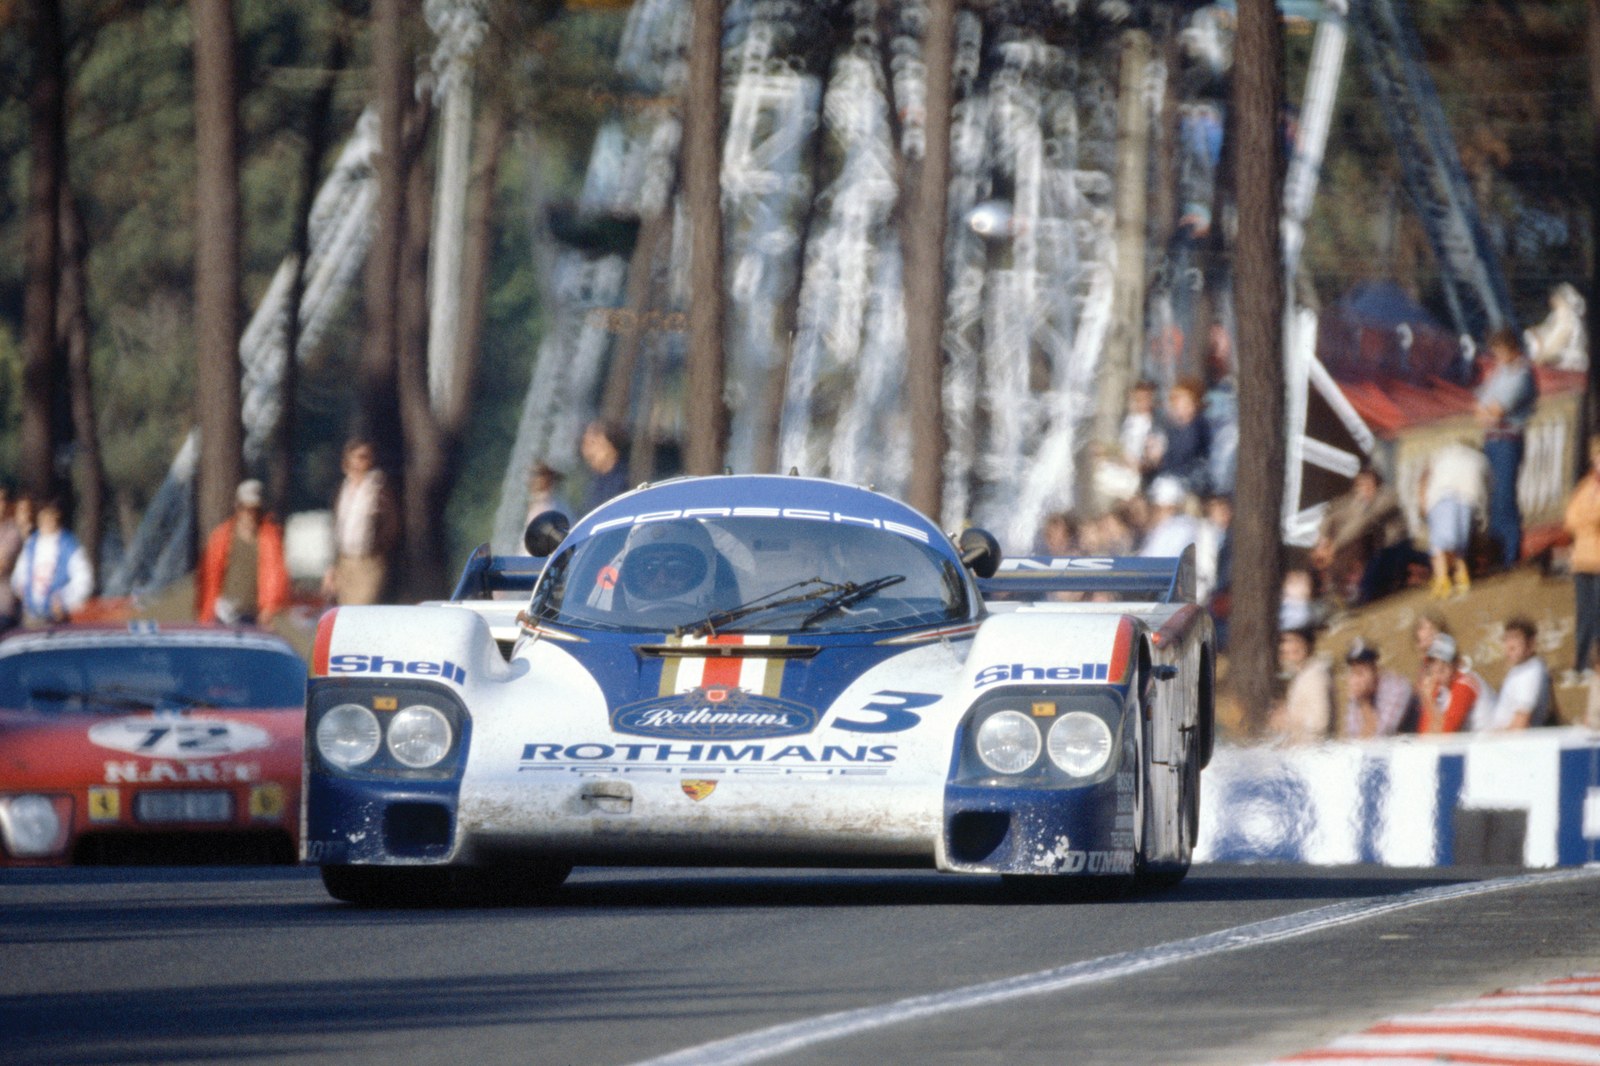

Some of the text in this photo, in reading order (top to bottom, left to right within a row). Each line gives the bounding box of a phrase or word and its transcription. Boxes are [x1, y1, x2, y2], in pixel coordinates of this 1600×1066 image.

[589, 508, 929, 543] PORSCHE
[330, 655, 466, 685] Shell
[974, 664, 1108, 689] Shell
[635, 707, 794, 727] Rothmans
[830, 690, 944, 734] 3
[126, 724, 232, 752] 72
[520, 743, 898, 762] ROTHMANS
